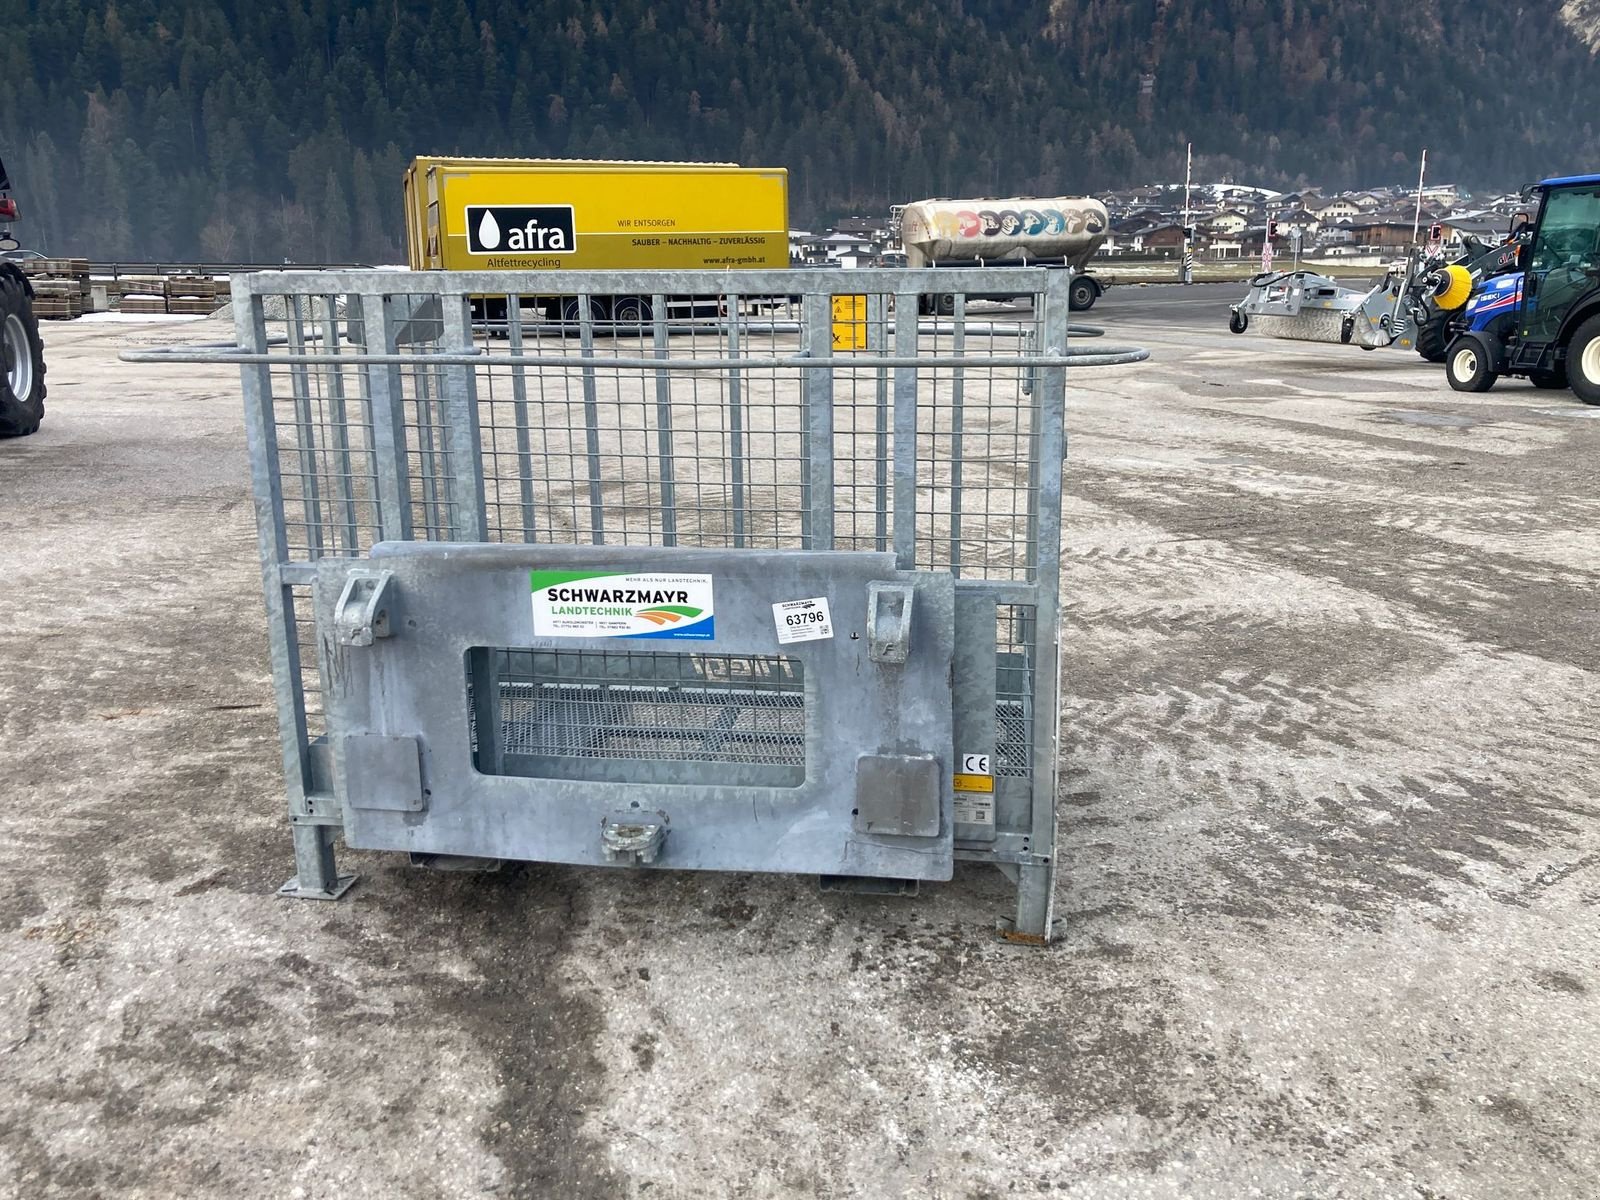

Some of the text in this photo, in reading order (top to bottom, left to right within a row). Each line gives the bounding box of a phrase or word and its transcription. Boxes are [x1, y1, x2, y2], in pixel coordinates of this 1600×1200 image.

[617, 219, 676, 227] WIR ENTSORGEN
[508, 219, 565, 250] afra
[632, 238, 661, 246] SAUBER
[668, 237, 712, 246] NACHHALTIG
[719, 235, 766, 245] ZUVERLÄSSIG
[487, 258, 561, 268] Altfettrecycling
[703, 256, 765, 265] www.afra-gmbh.at
[547, 588, 689, 604] SCHWARZMAYR
[551, 606, 633, 616] LANDTECHNIK
[786, 611, 824, 626] 63796
